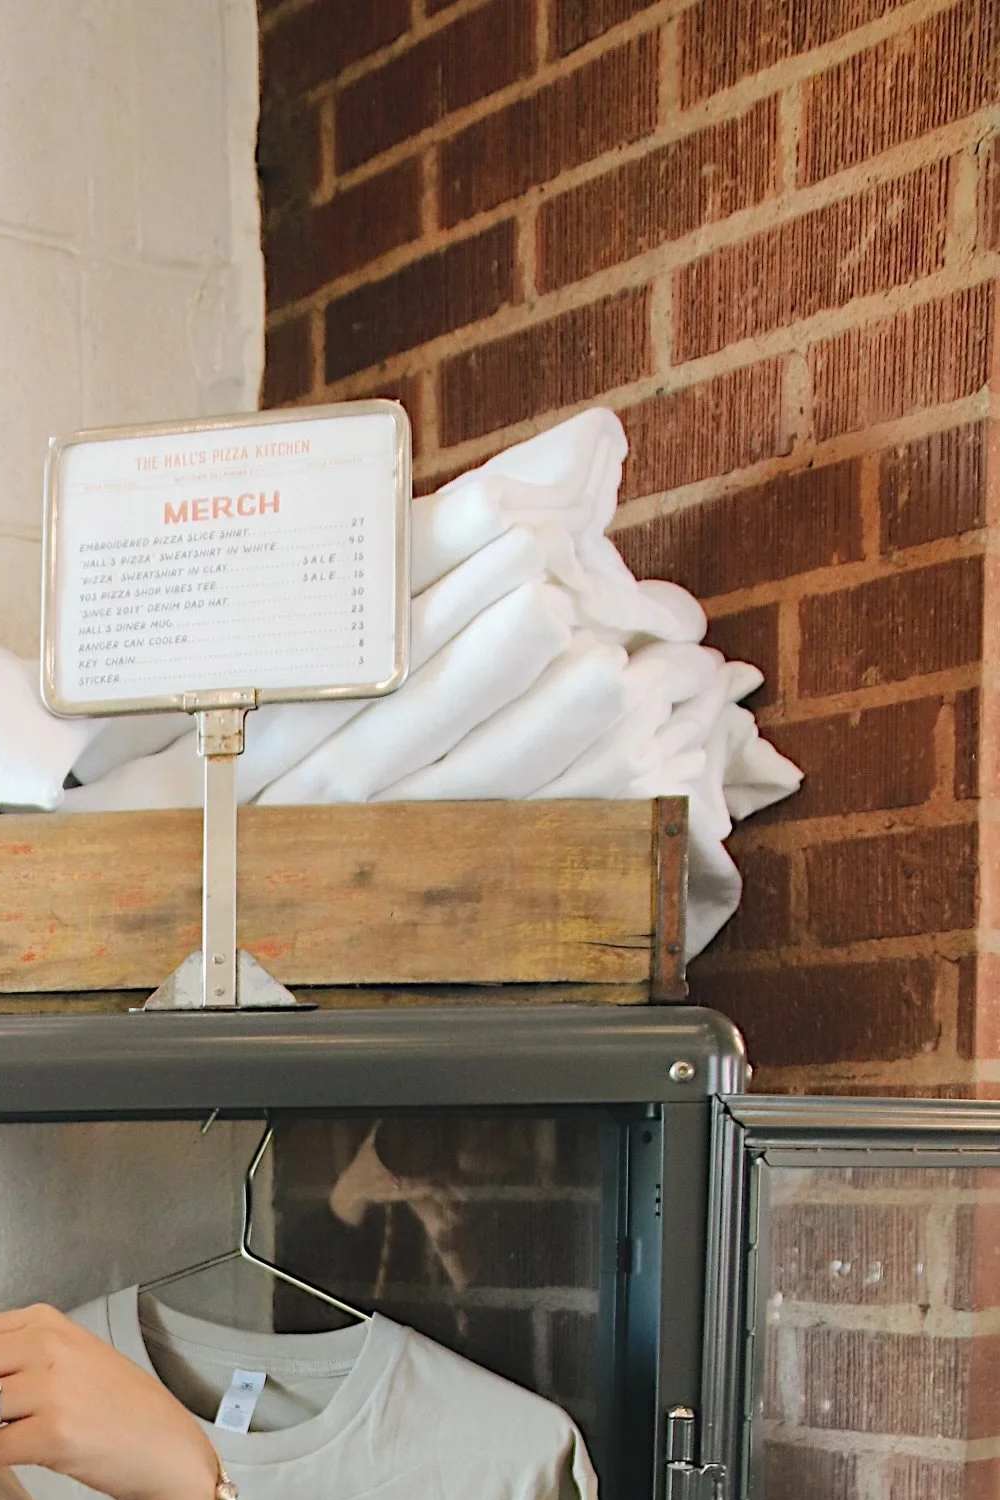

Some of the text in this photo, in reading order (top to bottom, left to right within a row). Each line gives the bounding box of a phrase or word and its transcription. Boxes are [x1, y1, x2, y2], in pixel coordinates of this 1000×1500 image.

[136, 439, 310, 471] THE HALL'S PIZZA KITCHEN
[164, 489, 280, 525] MERCH
[79, 517, 365, 554] EMBROIDERED PIZZA SLICE SHIRT 27
[159, 547, 221, 562] SWEATSHIRT
[226, 545, 238, 555] IN
[244, 542, 277, 553] WHITE
[349, 535, 364, 544] 40
[121, 568, 183, 582] SWEATSHIRT
[187, 566, 199, 575] IN
[203, 564, 228, 575] CLAY
[303, 553, 336, 565] SALE
[353, 552, 364, 561] 15
[101, 590, 131, 601] PIZZA
[134, 587, 161, 597] SHOP
[165, 584, 193, 595] VIBES
[197, 581, 217, 591] TEE
[303, 570, 336, 582] SALE
[115, 620, 146, 633] DINER
[150, 618, 173, 629] MUG
[351, 604, 364, 614] 23
[147, 601, 181, 613] DENIM
[184, 599, 205, 609] DAD
[209, 597, 229, 607] HAT
[78, 621, 364, 652] RANGER CAN COOLER 23
[78, 658, 98, 669] KEY
[105, 655, 136, 667] CHAIN
[78, 674, 120, 686] STICKER
